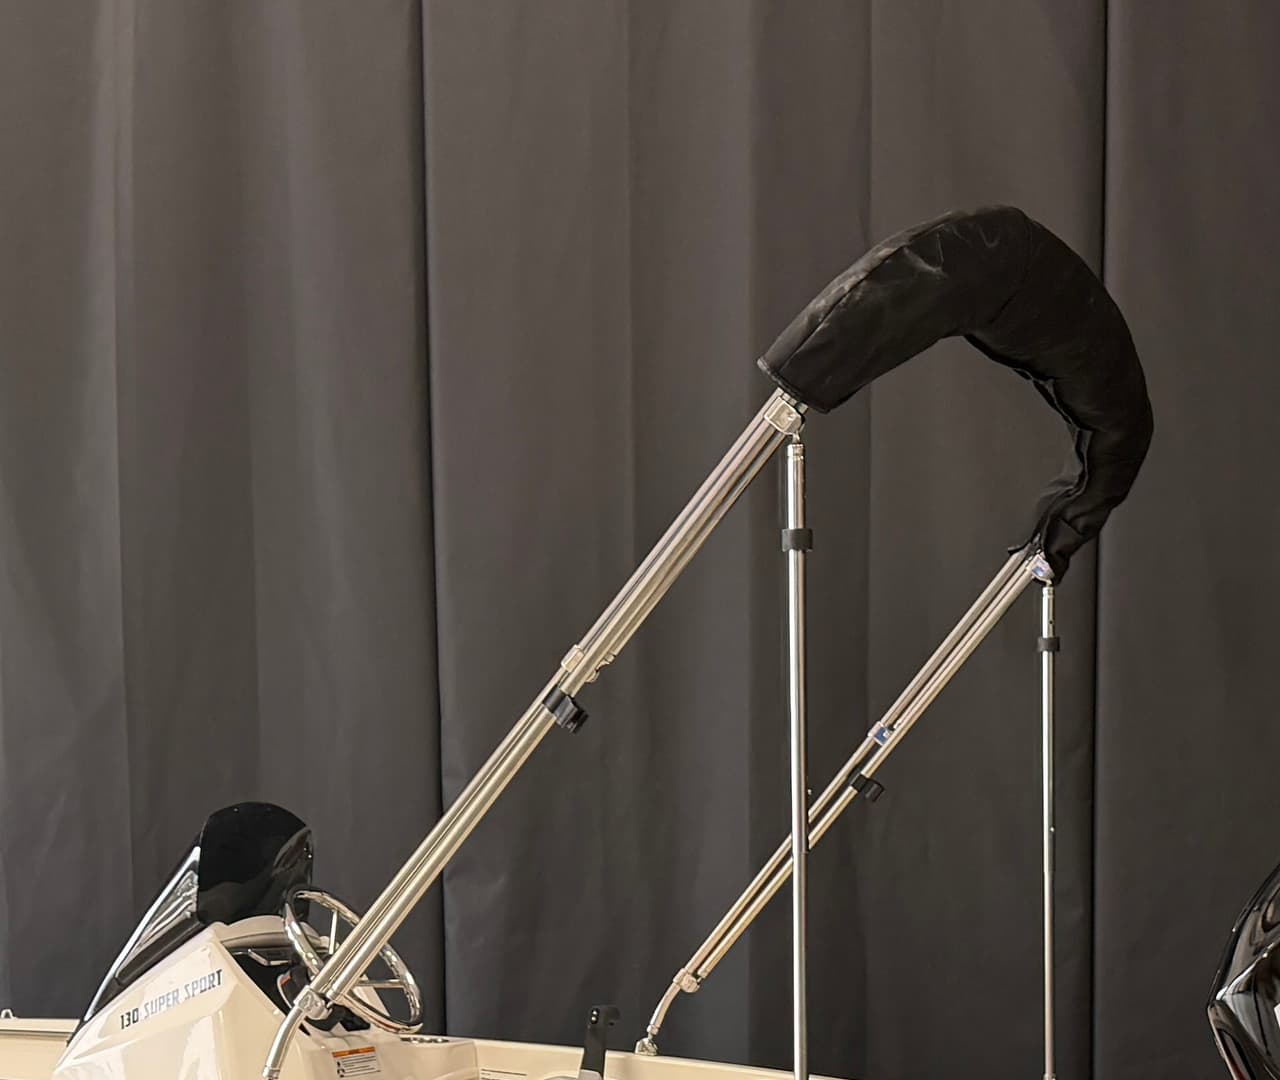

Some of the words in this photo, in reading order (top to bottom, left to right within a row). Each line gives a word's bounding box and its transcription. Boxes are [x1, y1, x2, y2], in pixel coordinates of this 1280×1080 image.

[120, 1007, 139, 1030] 130
[144, 988, 180, 1019] SUPER
[184, 968, 223, 1001] SPORT
